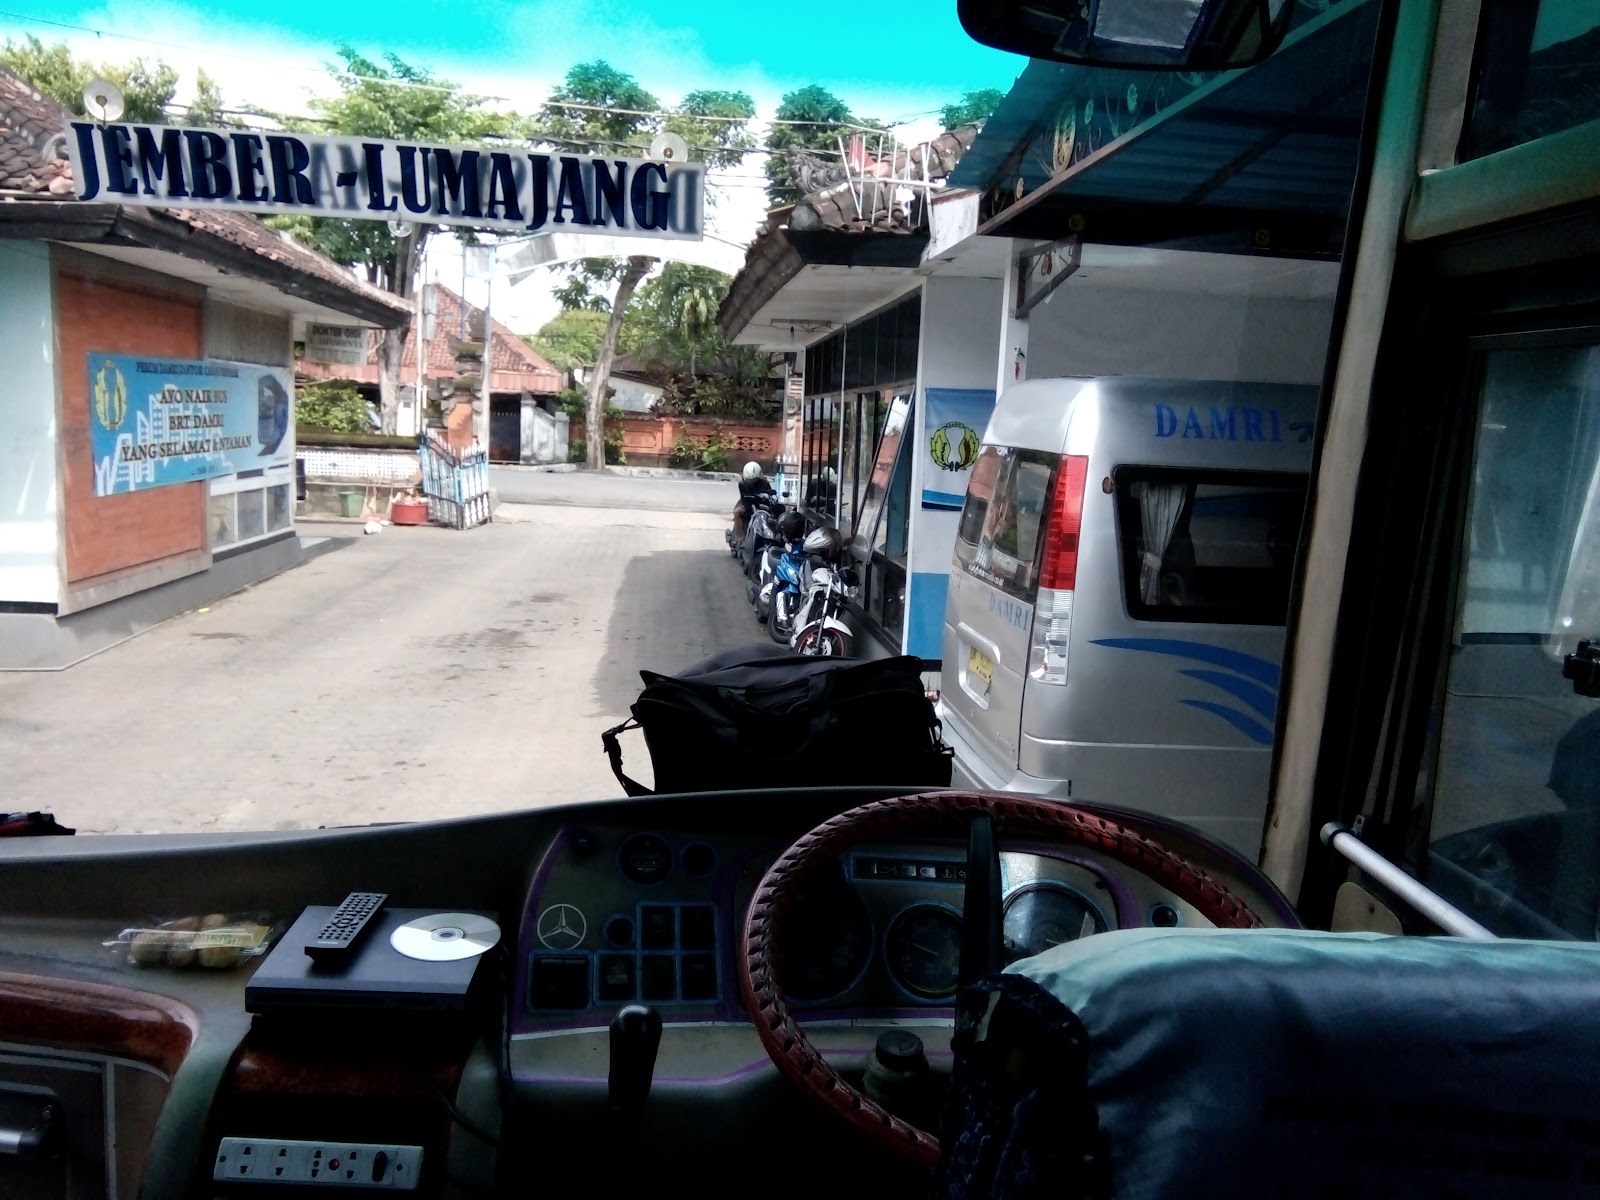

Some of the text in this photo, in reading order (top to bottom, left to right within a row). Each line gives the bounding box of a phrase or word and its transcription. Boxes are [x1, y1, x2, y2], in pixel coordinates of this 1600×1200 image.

[71, 122, 316, 205] JEMBER
[160, 389, 183, 404] AYO
[184, 389, 212, 404] NAIK
[169, 414, 225, 430] BRT DAMRI
[1154, 402, 1283, 443] DAMRI
[122, 444, 157, 461] YANG
[159, 439, 210, 458] SELAMAT
[989, 592, 1029, 631] DAMRI
